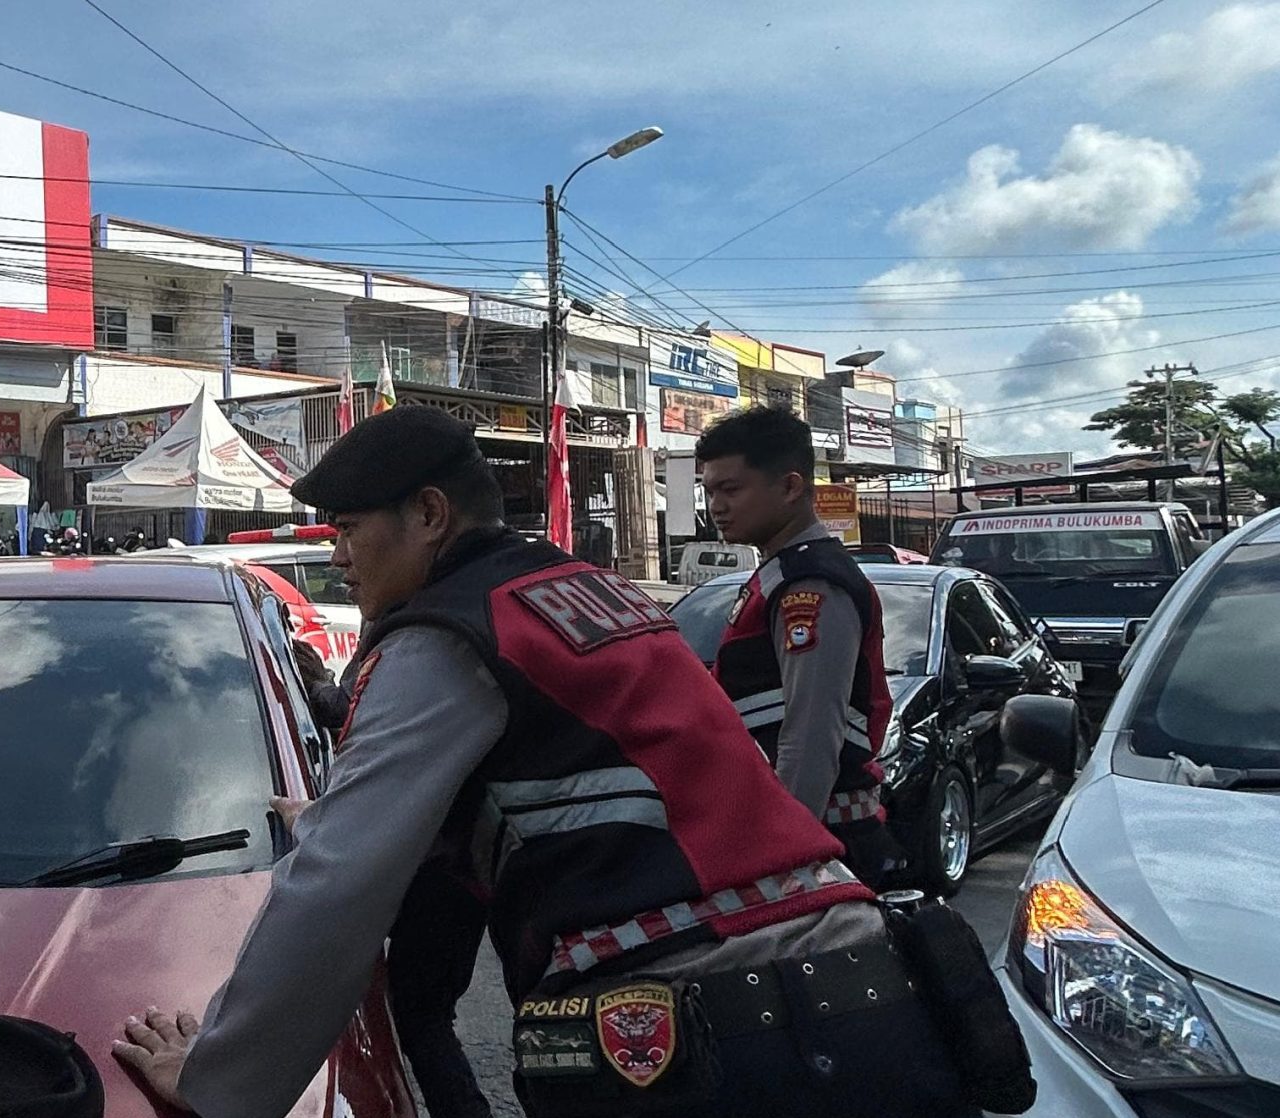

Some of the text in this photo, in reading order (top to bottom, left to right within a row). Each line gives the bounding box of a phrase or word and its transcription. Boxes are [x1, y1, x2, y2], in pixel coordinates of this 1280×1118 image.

[981, 462, 1062, 476] SHARP
[982, 515, 1143, 531] INDOPRIMA BULUKUMBA
[520, 998, 589, 1017] POLISI
